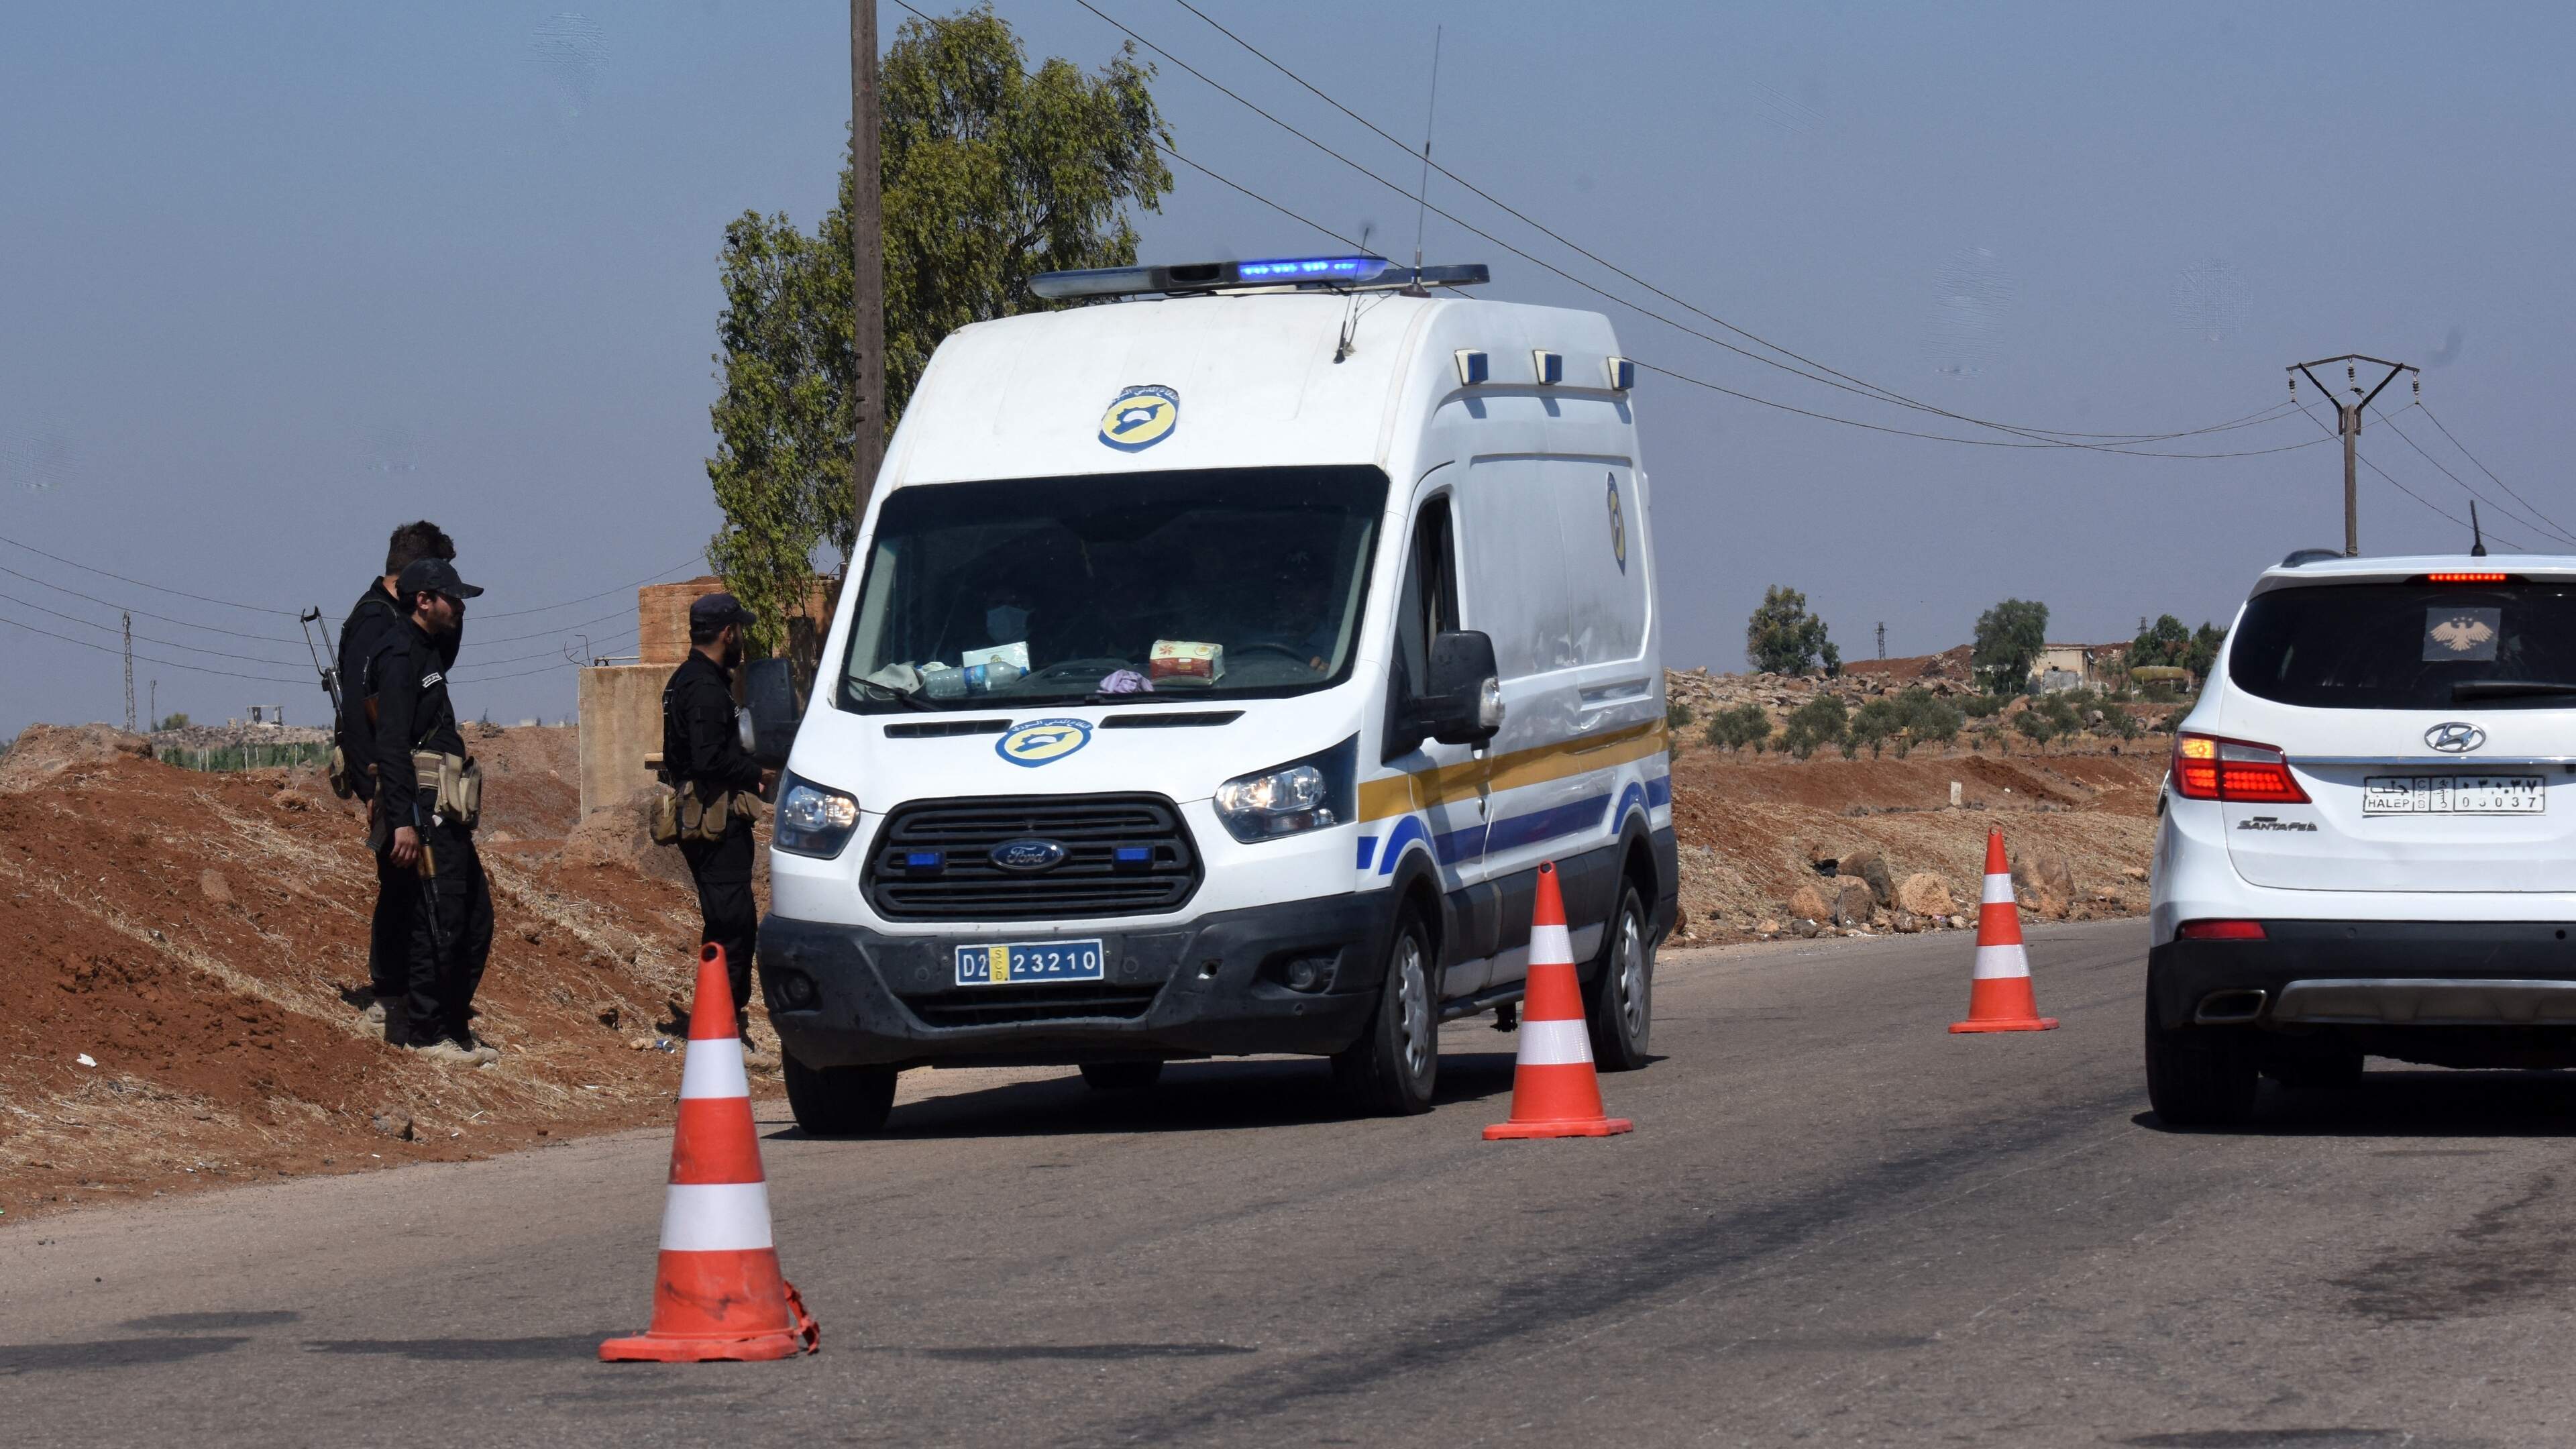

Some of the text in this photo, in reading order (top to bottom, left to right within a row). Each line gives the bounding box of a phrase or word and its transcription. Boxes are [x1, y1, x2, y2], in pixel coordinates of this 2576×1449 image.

[2368, 799, 2410, 808] HALEP
[2463, 797, 2536, 808] 03037
[1006, 846, 1046, 863] Ford
[963, 951, 1095, 977] D2 23210
[994, 949, 1004, 980] SCD
